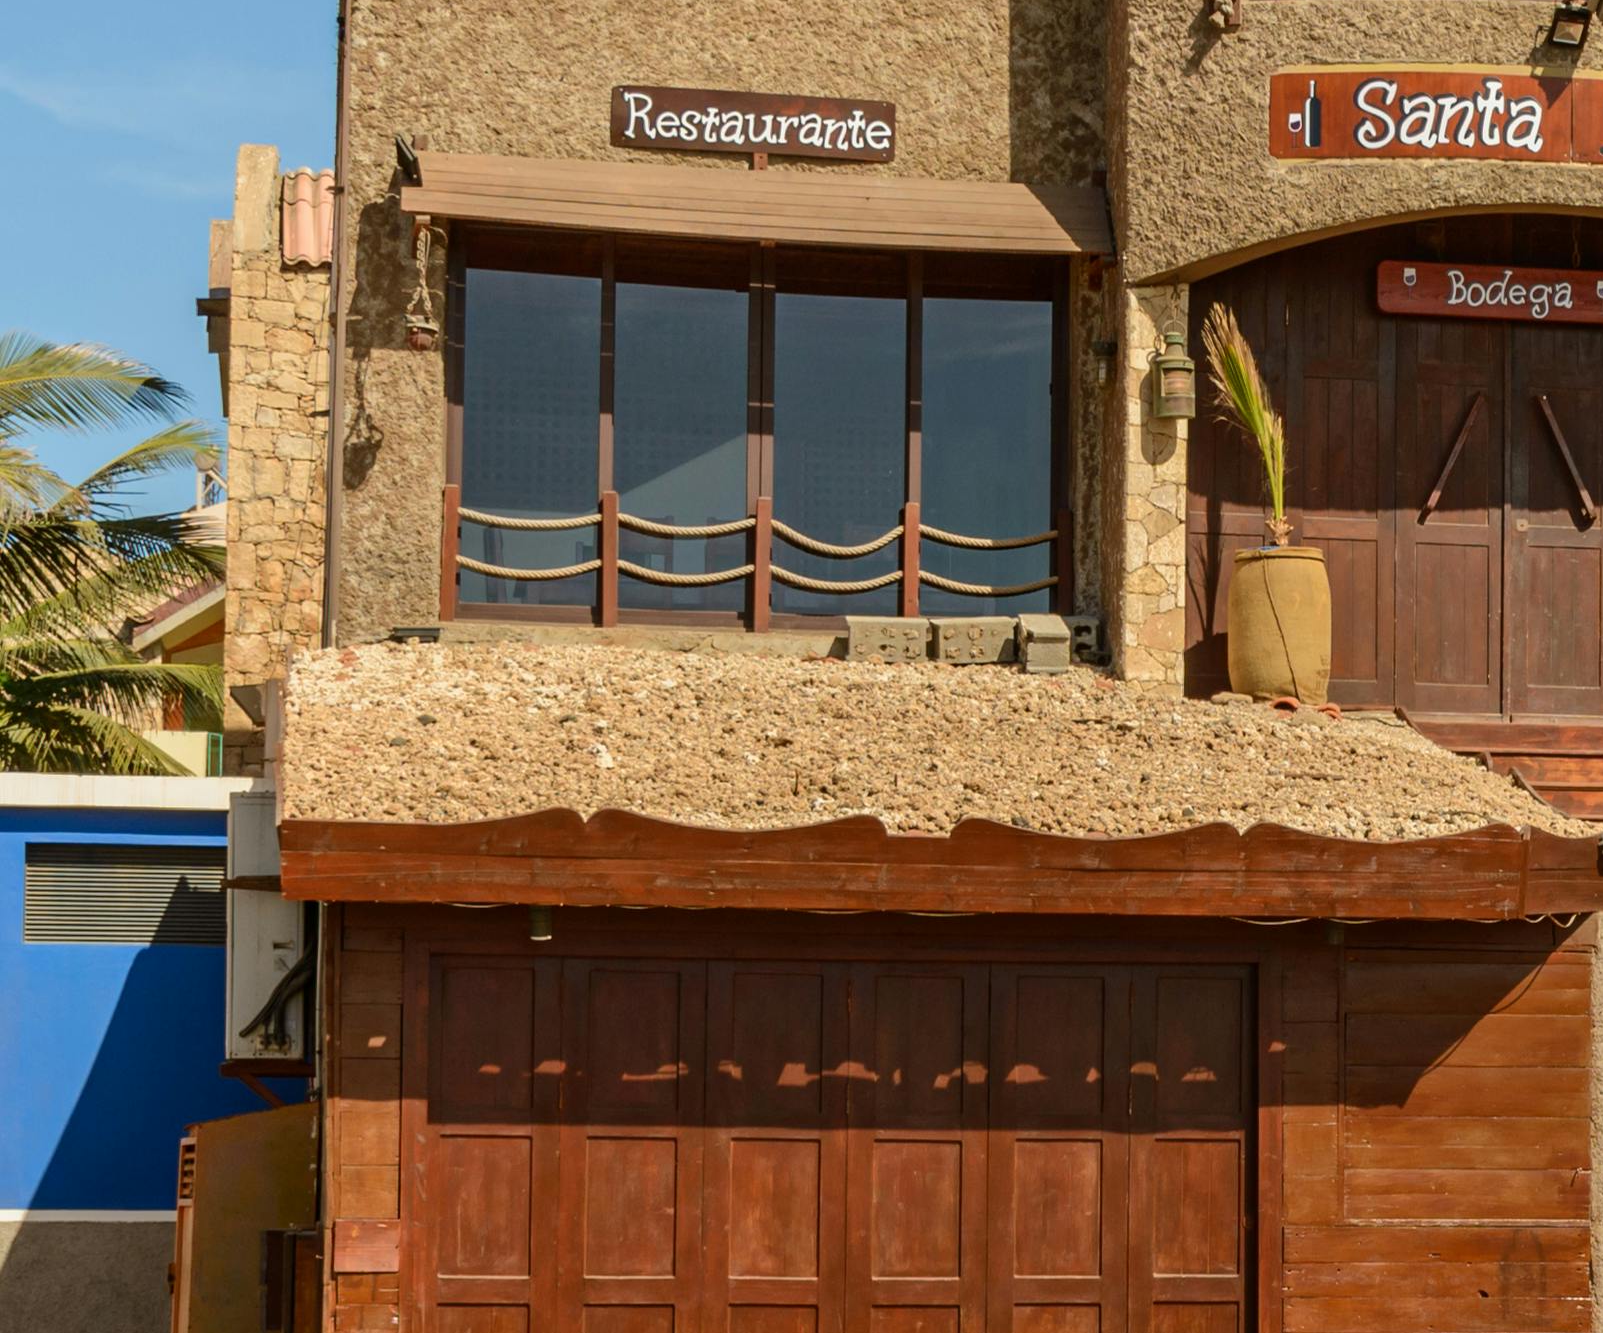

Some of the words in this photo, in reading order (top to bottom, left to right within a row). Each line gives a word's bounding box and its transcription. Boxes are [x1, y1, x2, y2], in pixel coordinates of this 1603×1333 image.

[624, 92, 892, 151] Restaurante
[1355, 77, 1544, 153] Santa
[1447, 270, 1573, 319] Bodega
